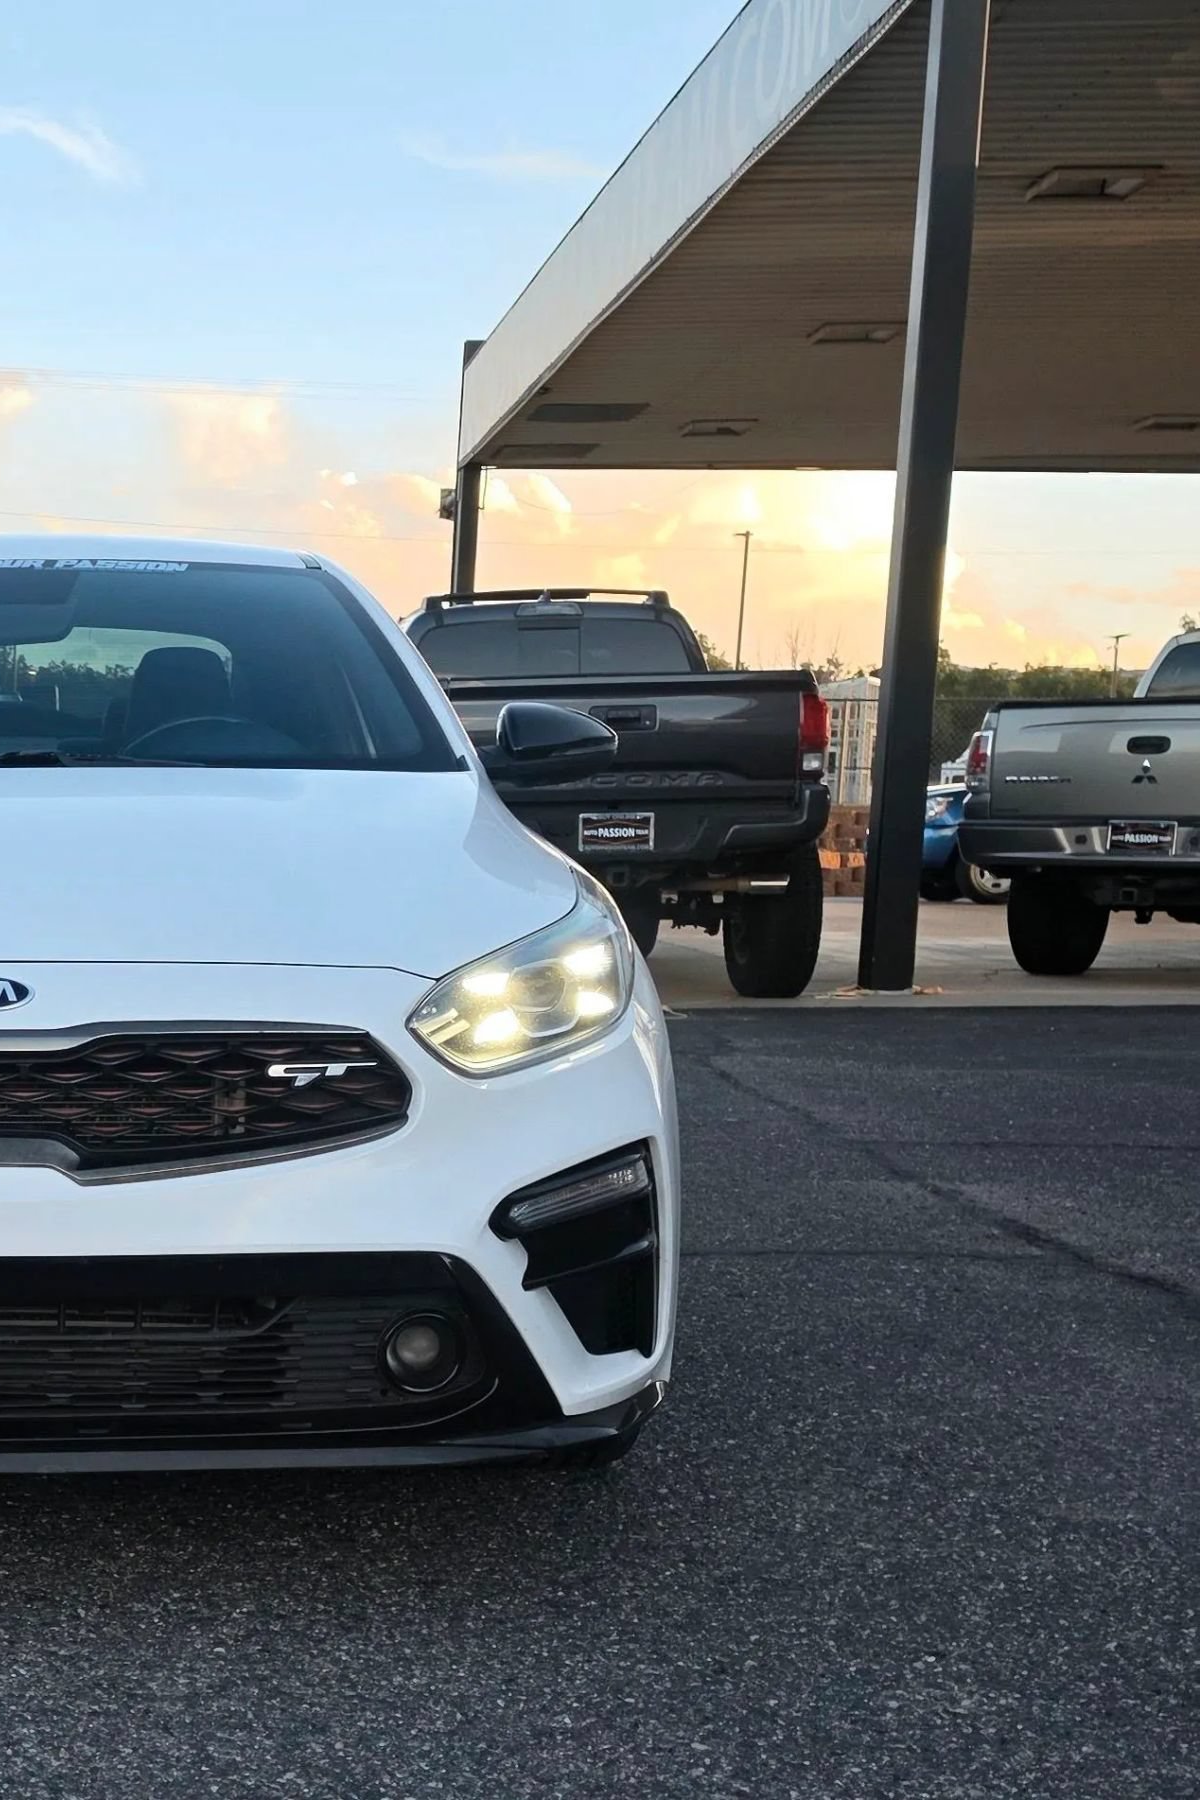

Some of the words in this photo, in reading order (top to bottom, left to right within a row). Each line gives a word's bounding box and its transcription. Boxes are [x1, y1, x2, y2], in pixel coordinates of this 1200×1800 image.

[53, 559, 189, 572] PASSION
[565, 771, 725, 788] COMA
[598, 827, 635, 837] PASSION
[1124, 833, 1159, 843] PASSION
[267, 1062, 378, 1087] GT
